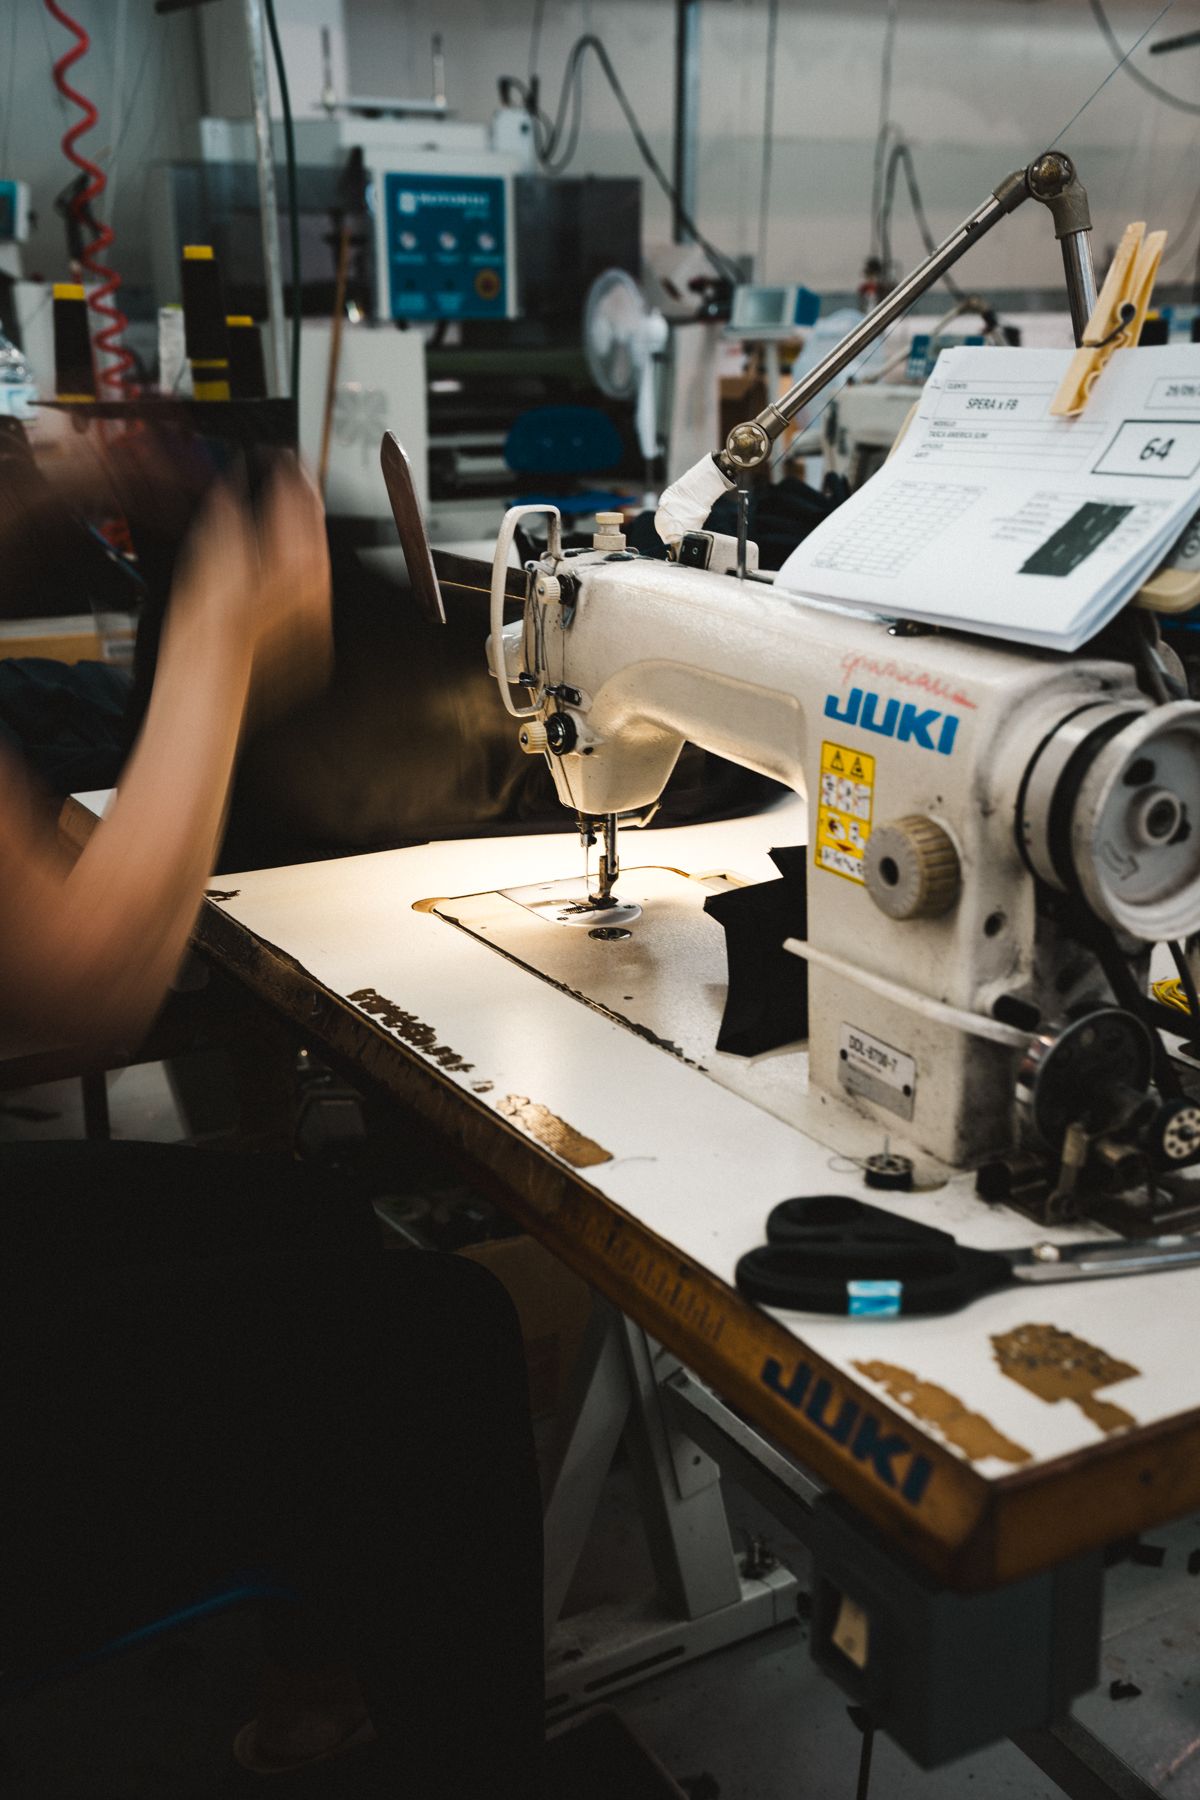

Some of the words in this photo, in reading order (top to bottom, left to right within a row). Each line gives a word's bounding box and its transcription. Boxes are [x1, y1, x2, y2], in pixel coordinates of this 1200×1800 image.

[966, 398, 997, 410] SPERA
[1005, 399, 1019, 410] FB
[1139, 438, 1176, 461] 64
[824, 688, 960, 756] JUKI
[761, 1357, 934, 1506] JUKI
